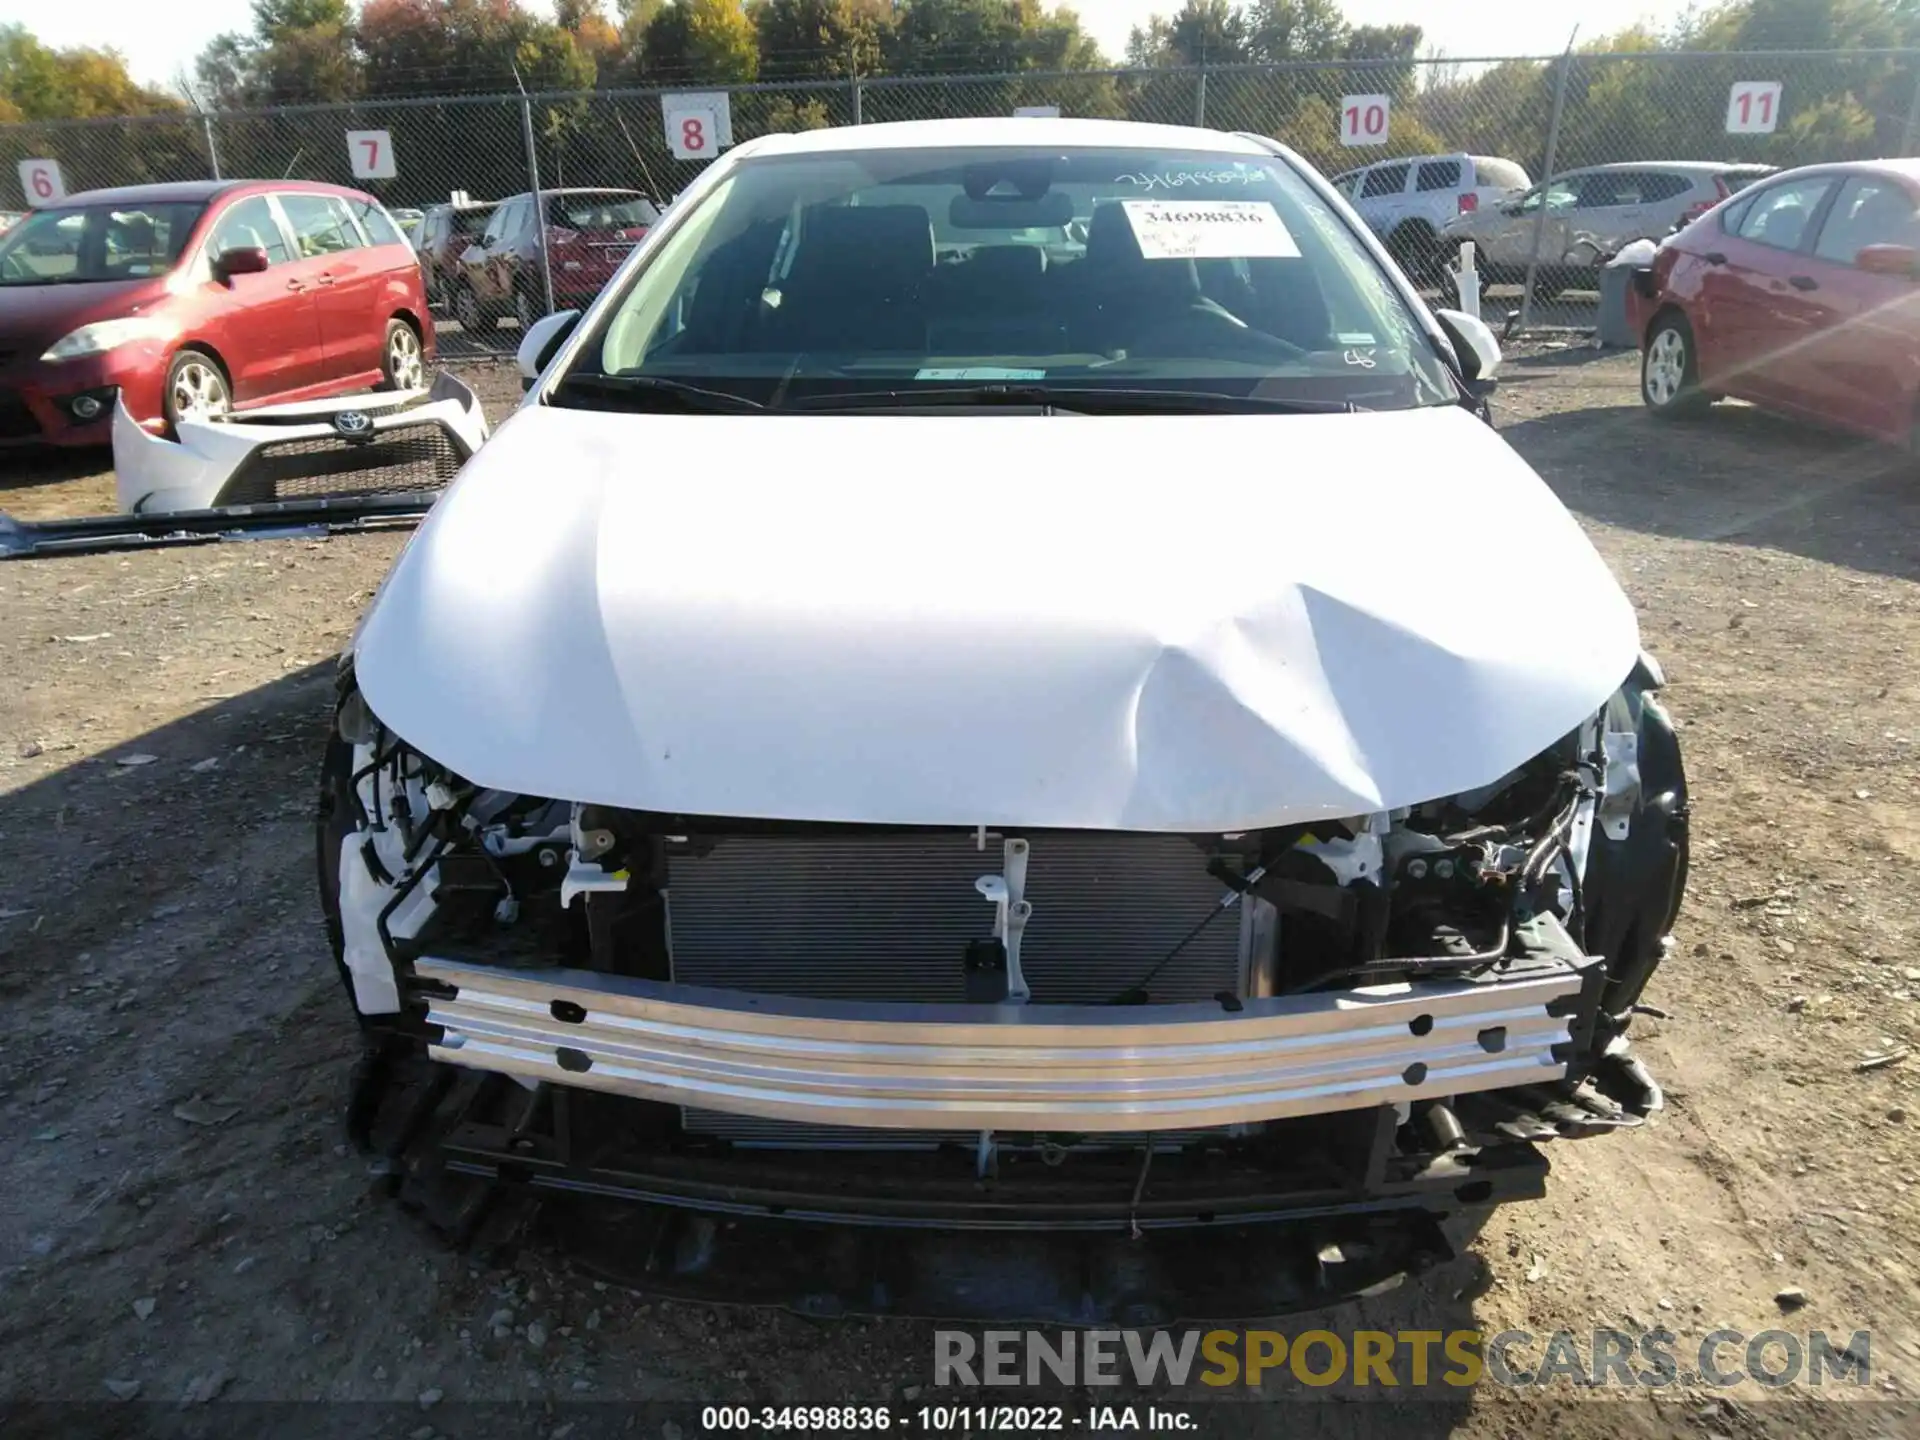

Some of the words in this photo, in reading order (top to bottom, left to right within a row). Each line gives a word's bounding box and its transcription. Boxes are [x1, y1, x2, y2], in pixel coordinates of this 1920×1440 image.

[1345, 104, 1384, 136] 10
[1737, 92, 1772, 124] 11
[682, 118, 704, 151] 8
[359, 139, 378, 170] 7
[32, 168, 53, 199] 6
[1144, 211, 1264, 225] 34698836
